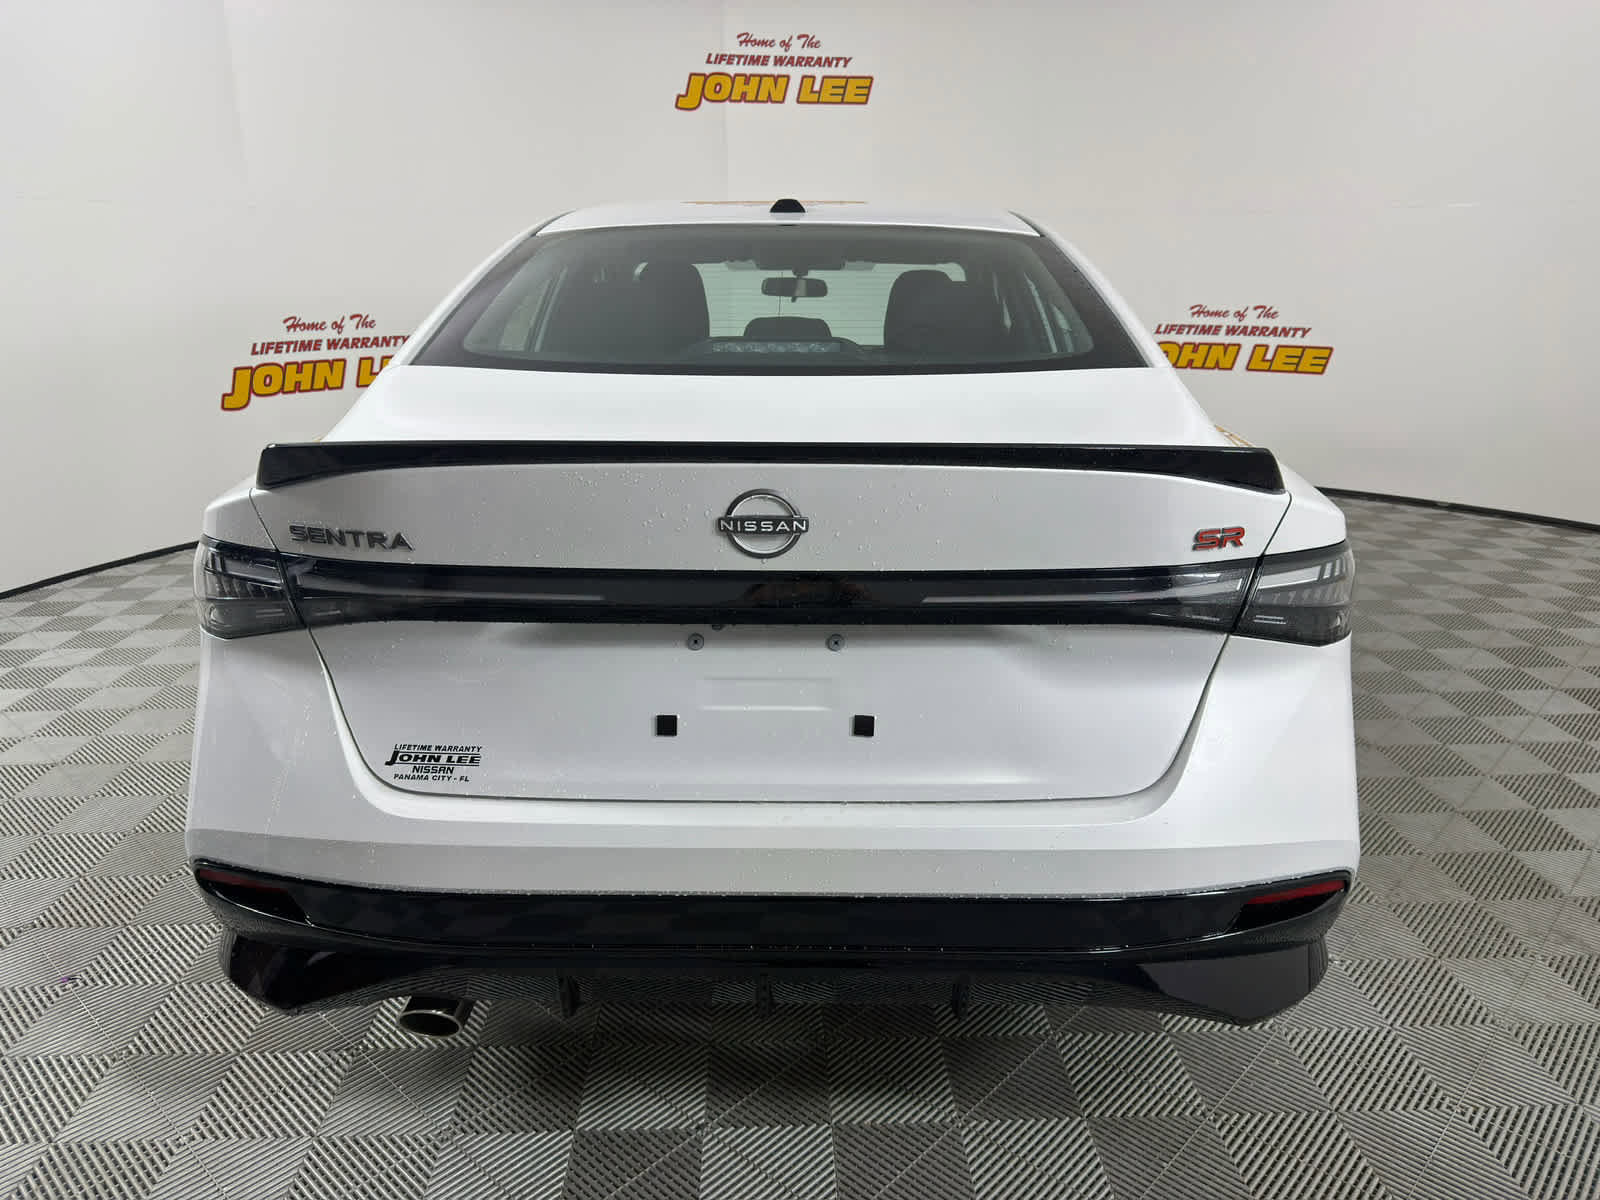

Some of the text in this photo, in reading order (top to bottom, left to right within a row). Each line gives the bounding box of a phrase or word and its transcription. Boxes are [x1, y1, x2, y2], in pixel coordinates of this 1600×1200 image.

[736, 32, 821, 52] Home of The
[706, 53, 853, 68] LIFETIME WARRANTY
[675, 72, 874, 111] JOHN LEE
[1189, 304, 1280, 322] Home of The
[283, 313, 376, 335] Home of The
[1155, 323, 1312, 338] LIFETIME WARRANTY
[251, 334, 411, 355] LIFETIME WARRANTY
[1246, 344, 1334, 376] LEE
[221, 358, 347, 411] JOHN
[720, 520, 807, 532] NISSAN
[289, 525, 415, 551] SENTRA
[1192, 526, 1245, 551] SR
[385, 750, 481, 766] JOHN LEE
[435, 744, 482, 752] WARRANTY
[412, 766, 454, 774] NISSAN
